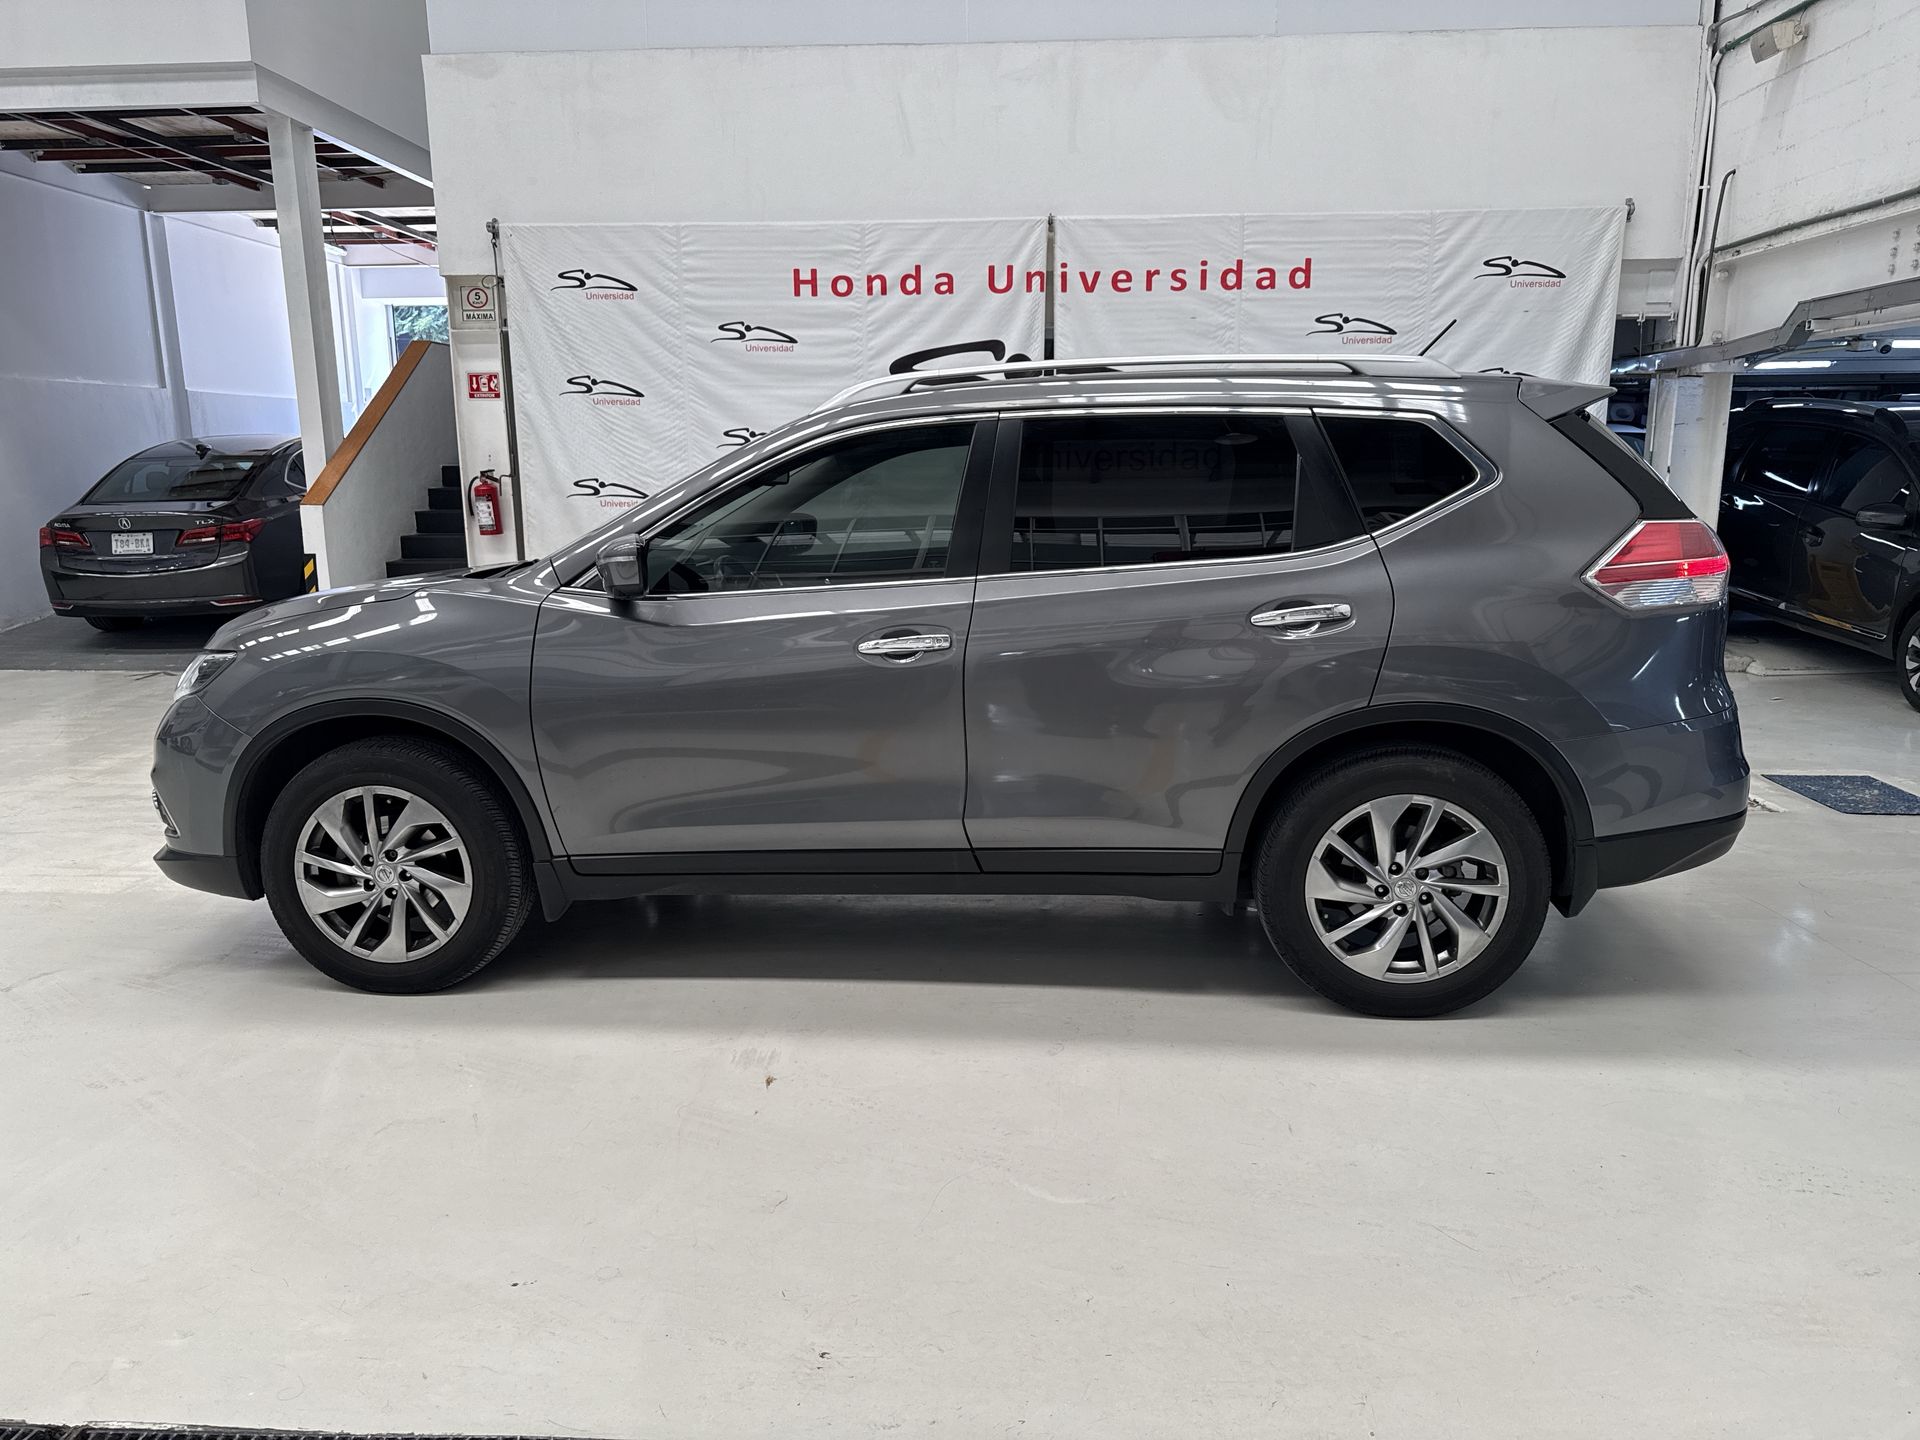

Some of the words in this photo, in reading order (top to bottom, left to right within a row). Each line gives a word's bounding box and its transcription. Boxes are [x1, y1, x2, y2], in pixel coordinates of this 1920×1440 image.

[793, 264, 955, 297] Honda
[987, 257, 1312, 294] Universidad
[1509, 279, 1561, 289] Universidad
[474, 291, 481, 301] 5
[585, 291, 635, 301] Universidad
[1341, 335, 1393, 345] Universidad
[745, 344, 794, 352] Universidad
[592, 397, 641, 406] Universidad
